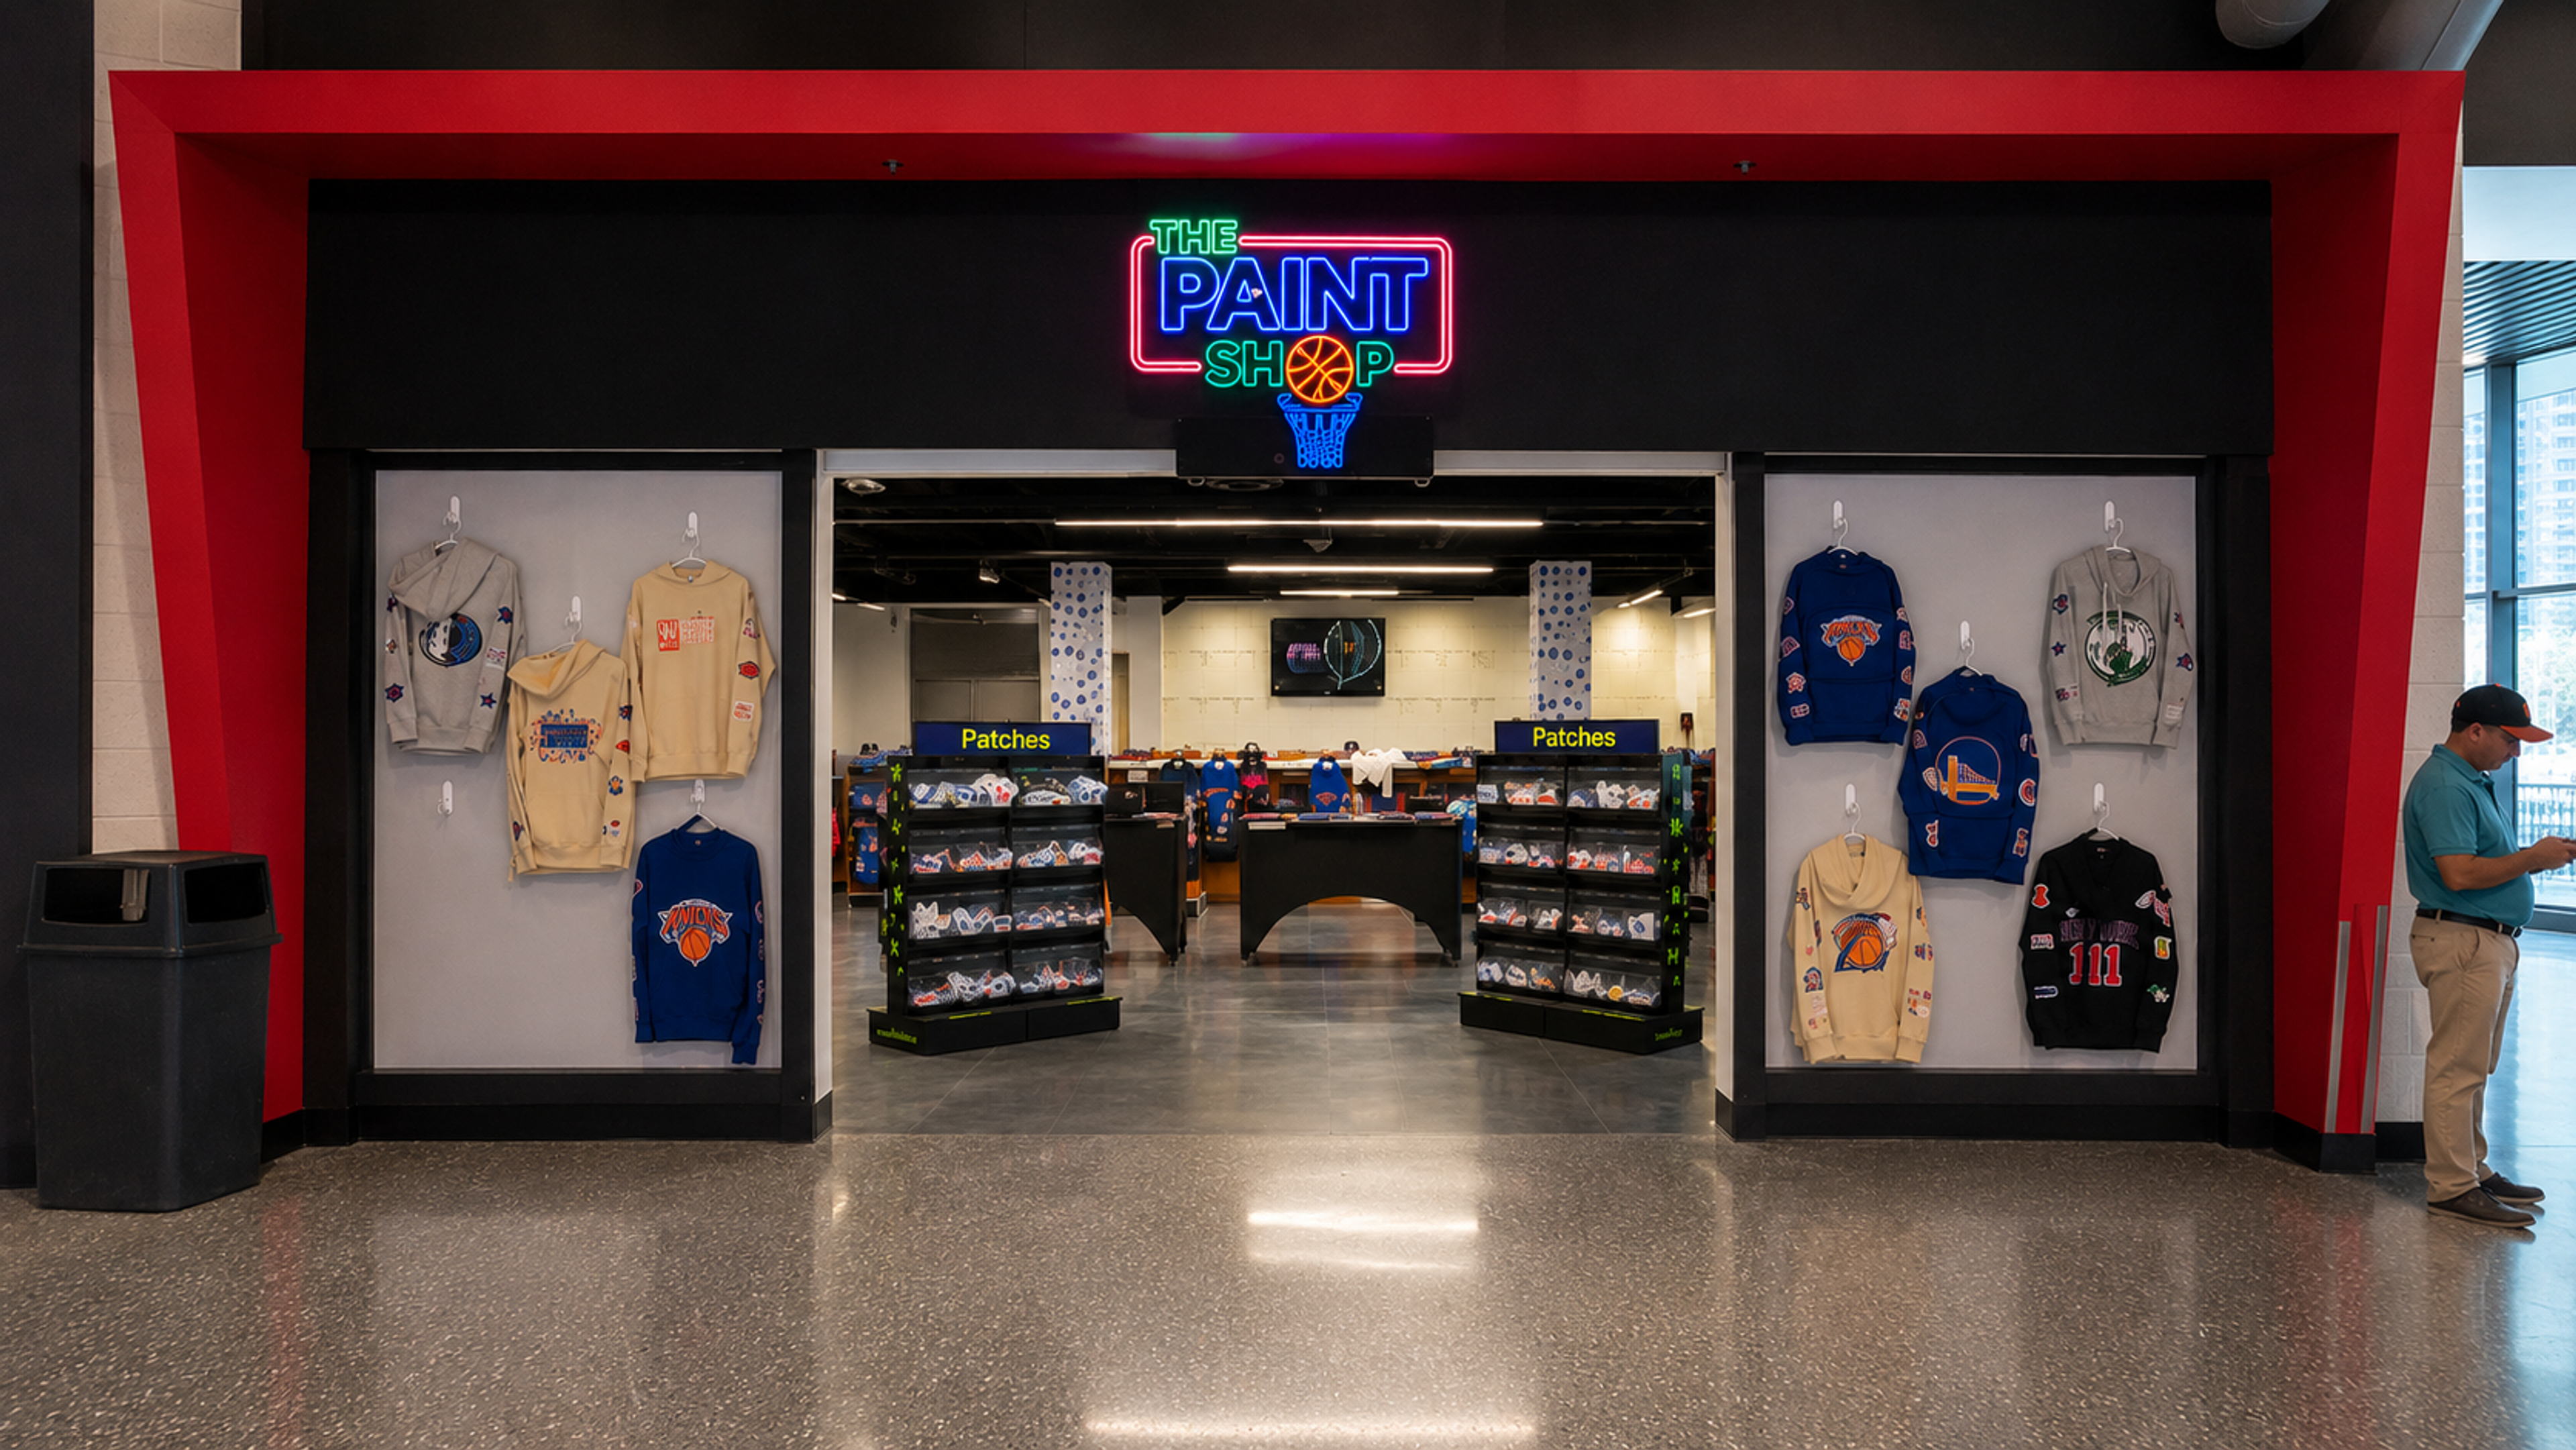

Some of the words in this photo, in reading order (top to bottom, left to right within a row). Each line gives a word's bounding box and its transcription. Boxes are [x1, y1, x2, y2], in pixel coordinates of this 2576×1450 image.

[1149, 219, 1238, 255] THE
[1160, 256, 1430, 332] PAINT
[962, 729, 1051, 749] Patches
[1534, 727, 1616, 747] Patches
